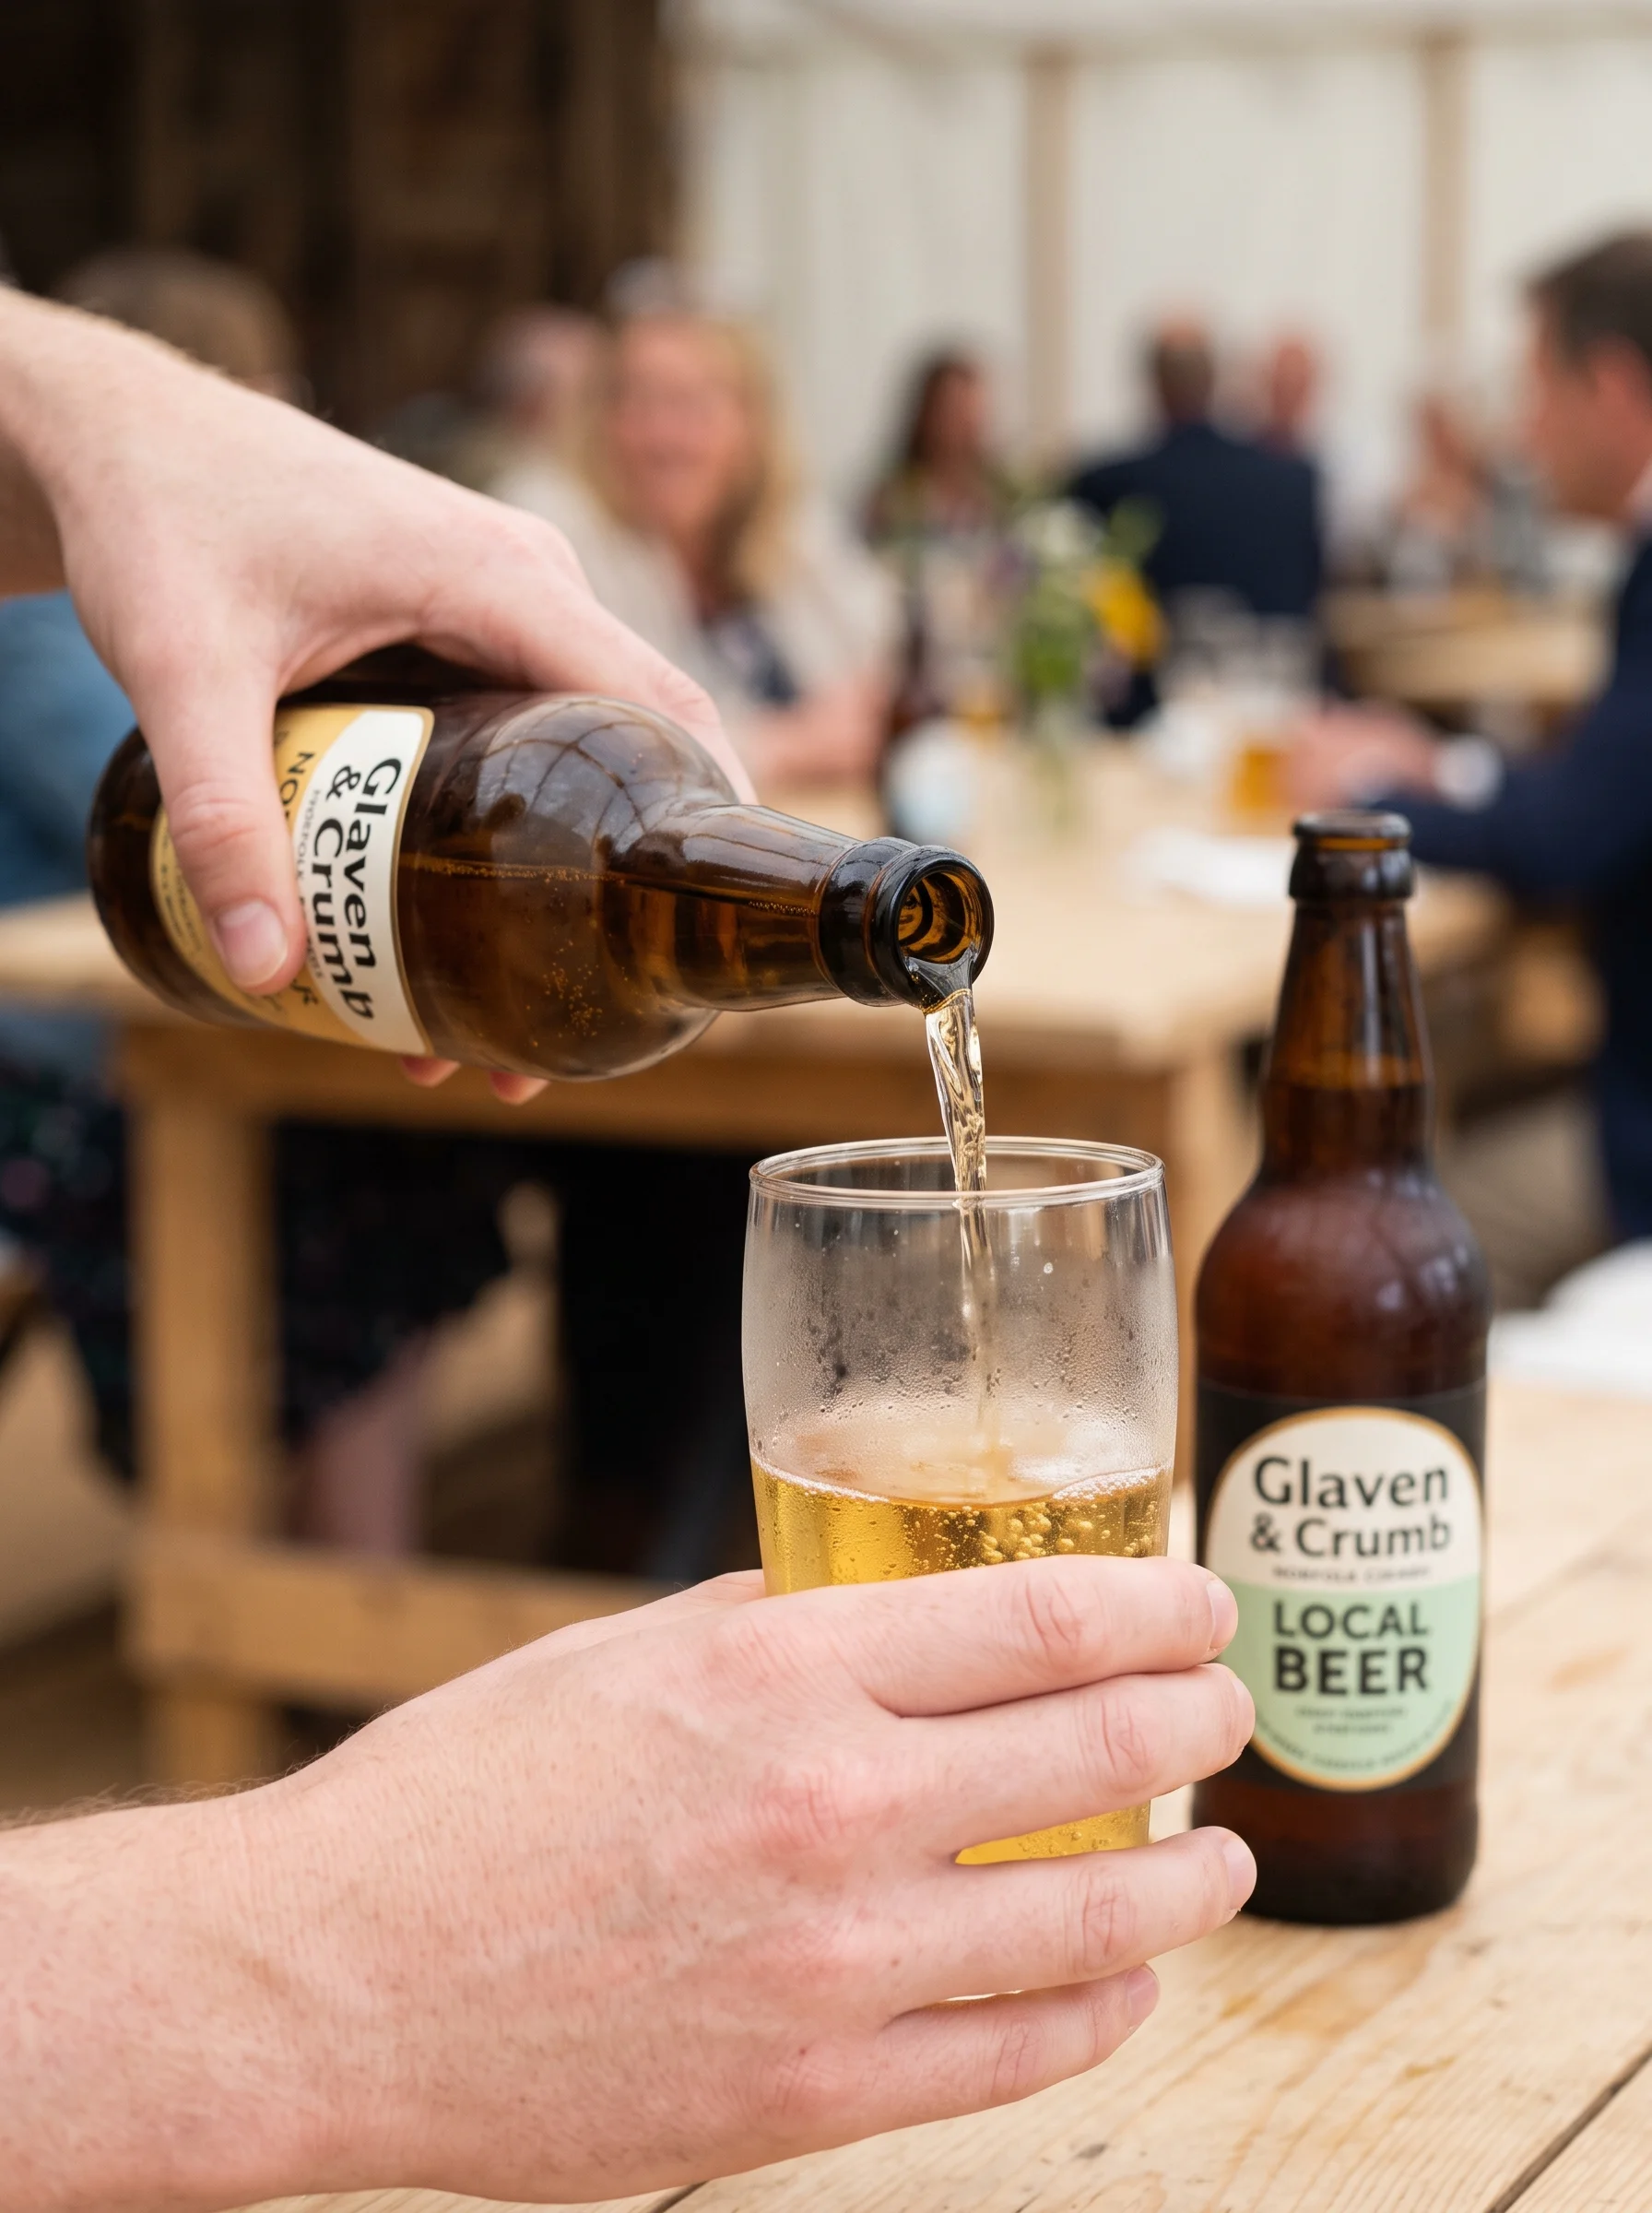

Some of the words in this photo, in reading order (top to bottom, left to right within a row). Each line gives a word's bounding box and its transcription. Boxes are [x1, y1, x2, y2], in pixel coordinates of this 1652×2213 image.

[325, 764, 361, 801] &
[344, 757, 402, 967] Glaven
[312, 818, 374, 1019] Crumb
[1253, 1456, 1448, 1509] Glaven
[1250, 1511, 1281, 1554] &
[1295, 1512, 1451, 1557] Crumb
[1274, 1600, 1430, 1640] LOCAL
[1275, 1645, 1428, 1696] BEER
